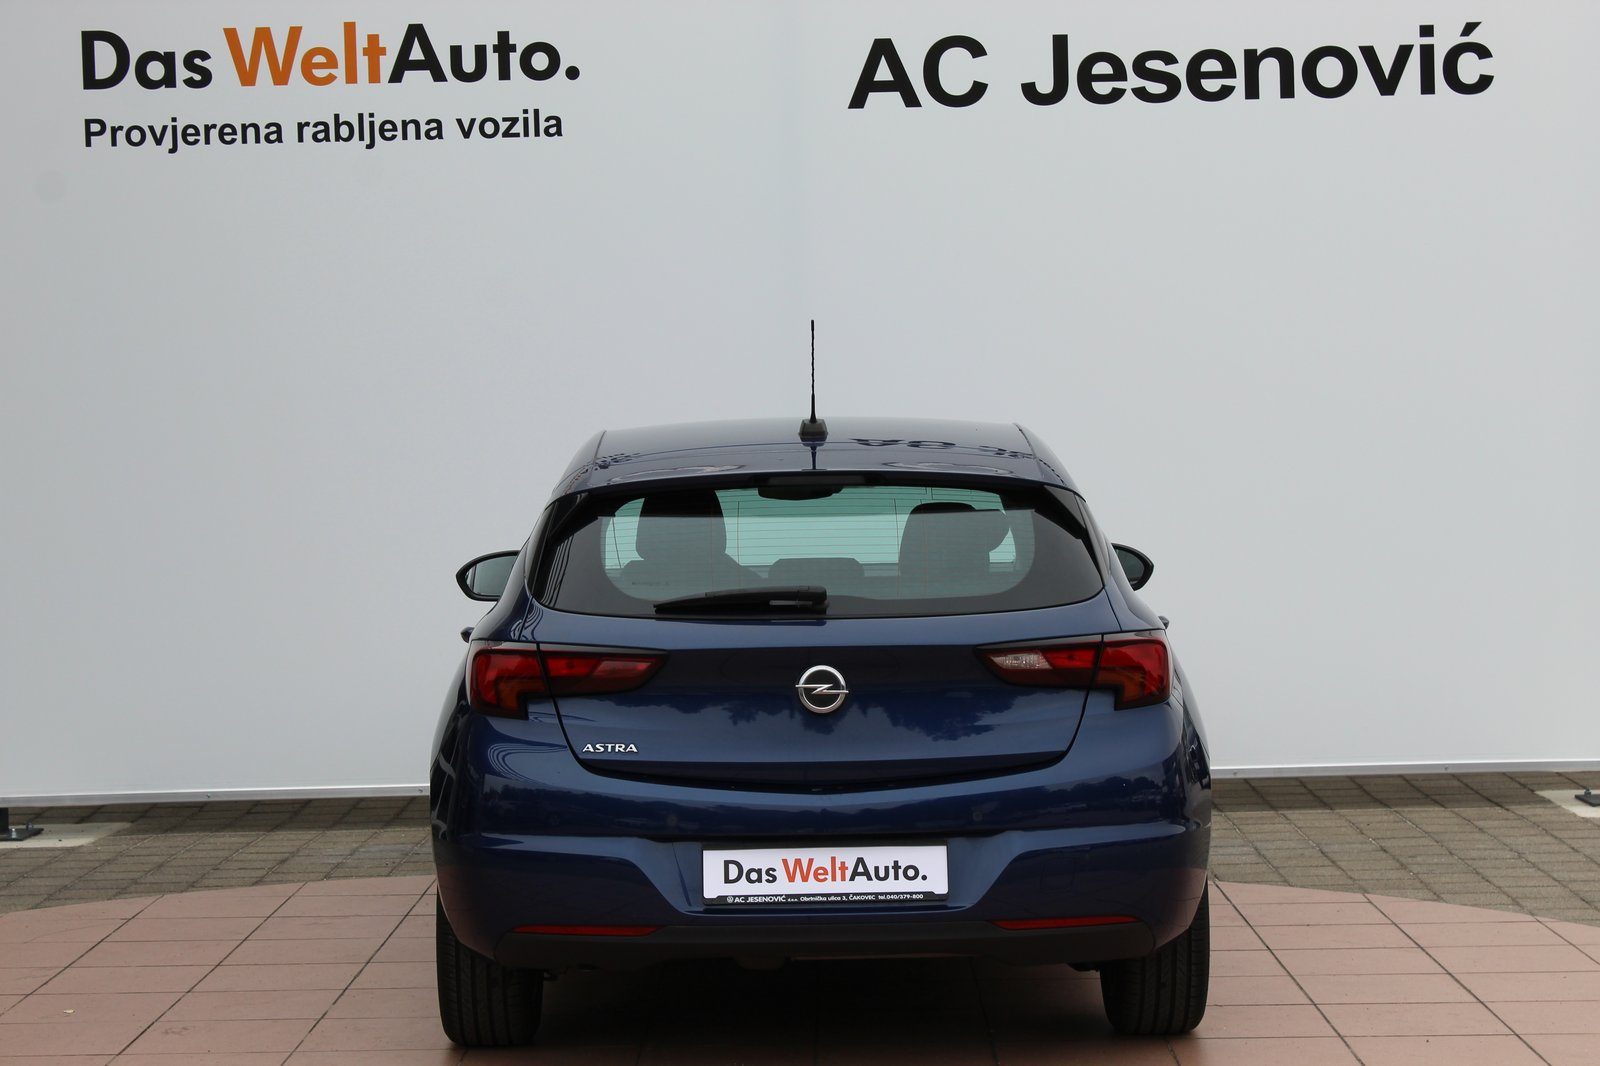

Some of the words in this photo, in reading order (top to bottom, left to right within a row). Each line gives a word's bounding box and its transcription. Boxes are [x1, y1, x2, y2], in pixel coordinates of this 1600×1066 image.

[80, 30, 213, 90] Das
[222, 21, 581, 88] WeltAuto.
[847, 35, 989, 109] AC
[1020, 21, 1495, 106] Jesenović
[83, 117, 284, 155] Provjerena
[297, 112, 444, 150] rabljena
[455, 108, 563, 140] vozila
[582, 743, 638, 753] ASTRA
[723, 859, 778, 885] Das
[781, 855, 929, 884] WeltAuto.
[746, 894, 786, 903] JESENOVIĆ
[849, 893, 876, 901] ČAKOVEC
